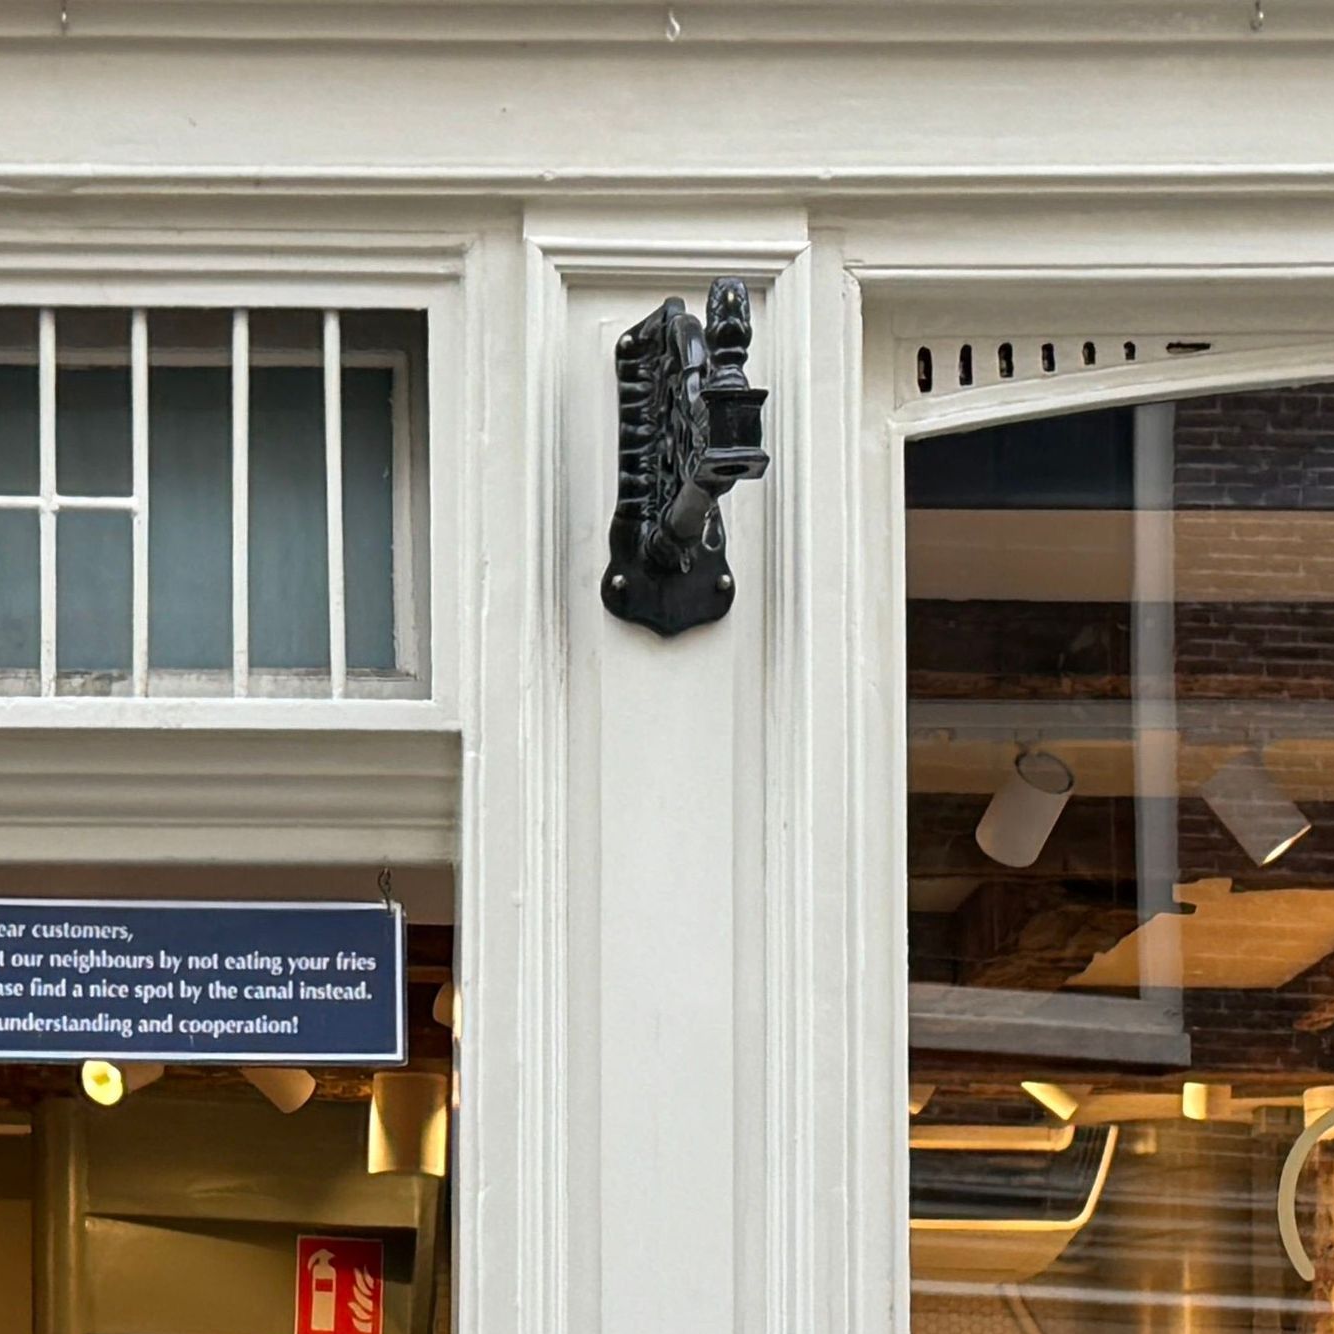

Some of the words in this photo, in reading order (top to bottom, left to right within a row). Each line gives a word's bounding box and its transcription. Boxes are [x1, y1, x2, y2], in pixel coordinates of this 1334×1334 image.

[31, 921, 134, 943] customers,
[10, 952, 44, 968] our
[49, 948, 155, 974] neighbours
[159, 949, 183, 975] by
[187, 952, 219, 970] not
[224, 950, 284, 976] eating
[287, 956, 331, 976] your
[335, 951, 377, 971] fries
[29, 976, 67, 998] find
[71, 983, 84, 998] a
[88, 978, 130, 999] nice
[133, 981, 175, 1005] spot
[179, 979, 203, 1005] by
[207, 979, 239, 1000] the
[243, 979, 294, 1000] canal
[299, 980, 373, 1001] instead.
[137, 1013, 174, 1034] and
[178, 1014, 299, 1038] cooperation!
